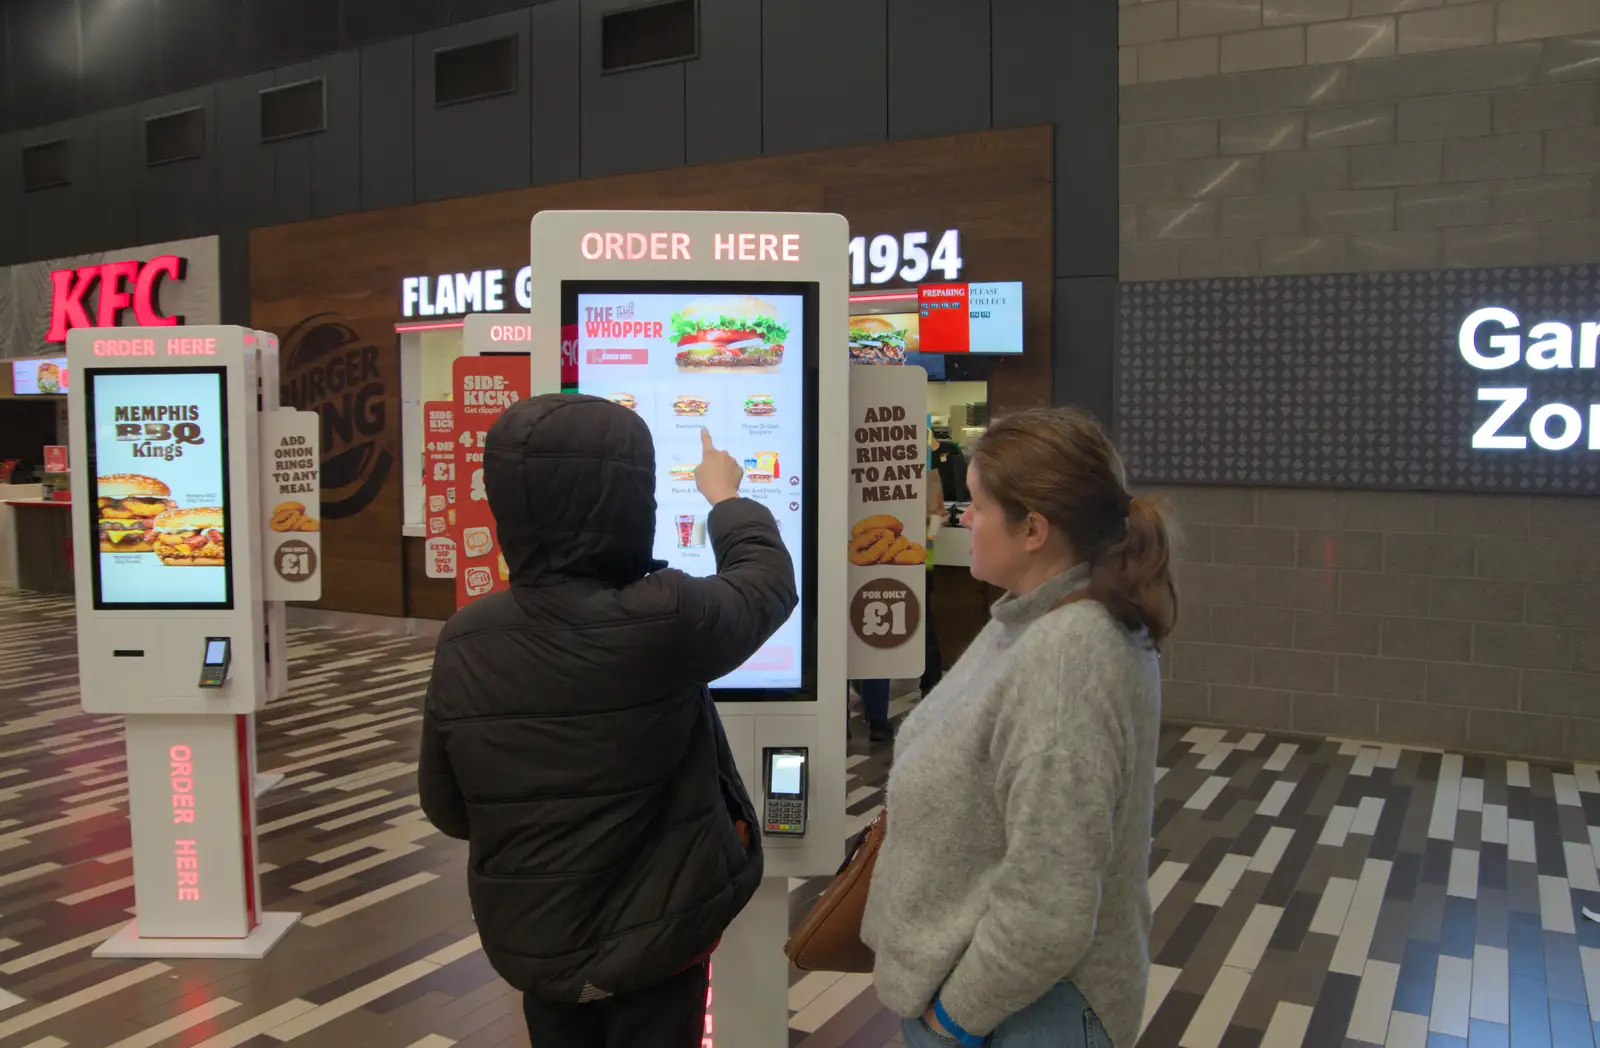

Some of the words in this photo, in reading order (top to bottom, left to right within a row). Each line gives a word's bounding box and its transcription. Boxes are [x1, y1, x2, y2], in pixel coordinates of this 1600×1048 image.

[581, 232, 691, 260] ORDER
[713, 233, 800, 262] HERE
[849, 229, 963, 285] 1954
[46, 255, 183, 342] KFC
[402, 268, 505, 317] FLAME
[923, 288, 965, 297] PREPARING
[970, 297, 1006, 305] COLLECT
[585, 306, 613, 322] THE
[585, 321, 663, 339] WHOPPER
[93, 339, 156, 356] ORDER
[166, 338, 217, 355] HERE
[463, 375, 509, 390] SIDE-
[463, 390, 519, 409] KICKS
[114, 405, 199, 421] MEMPHIS
[464, 406, 477, 414] Get
[864, 406, 905, 423] ADD
[280, 436, 306, 447] ADD
[458, 431, 474, 447] 4
[855, 424, 917, 443] ONION
[274, 447, 314, 459] ONION
[856, 444, 918, 463] RINGS
[275, 459, 314, 471] RINGS
[851, 466, 880, 483] TO
[883, 463, 925, 482] ANY
[272, 473, 290, 483] TO
[292, 470, 318, 482] ANY
[279, 483, 314, 494] MEAL
[862, 484, 917, 502] MEAL
[281, 553, 310, 576] £1
[862, 591, 882, 599] FOR
[882, 590, 907, 599] ONLY
[862, 601, 907, 635] £1
[169, 745, 196, 824] ORDER
[174, 839, 200, 901] HERE
